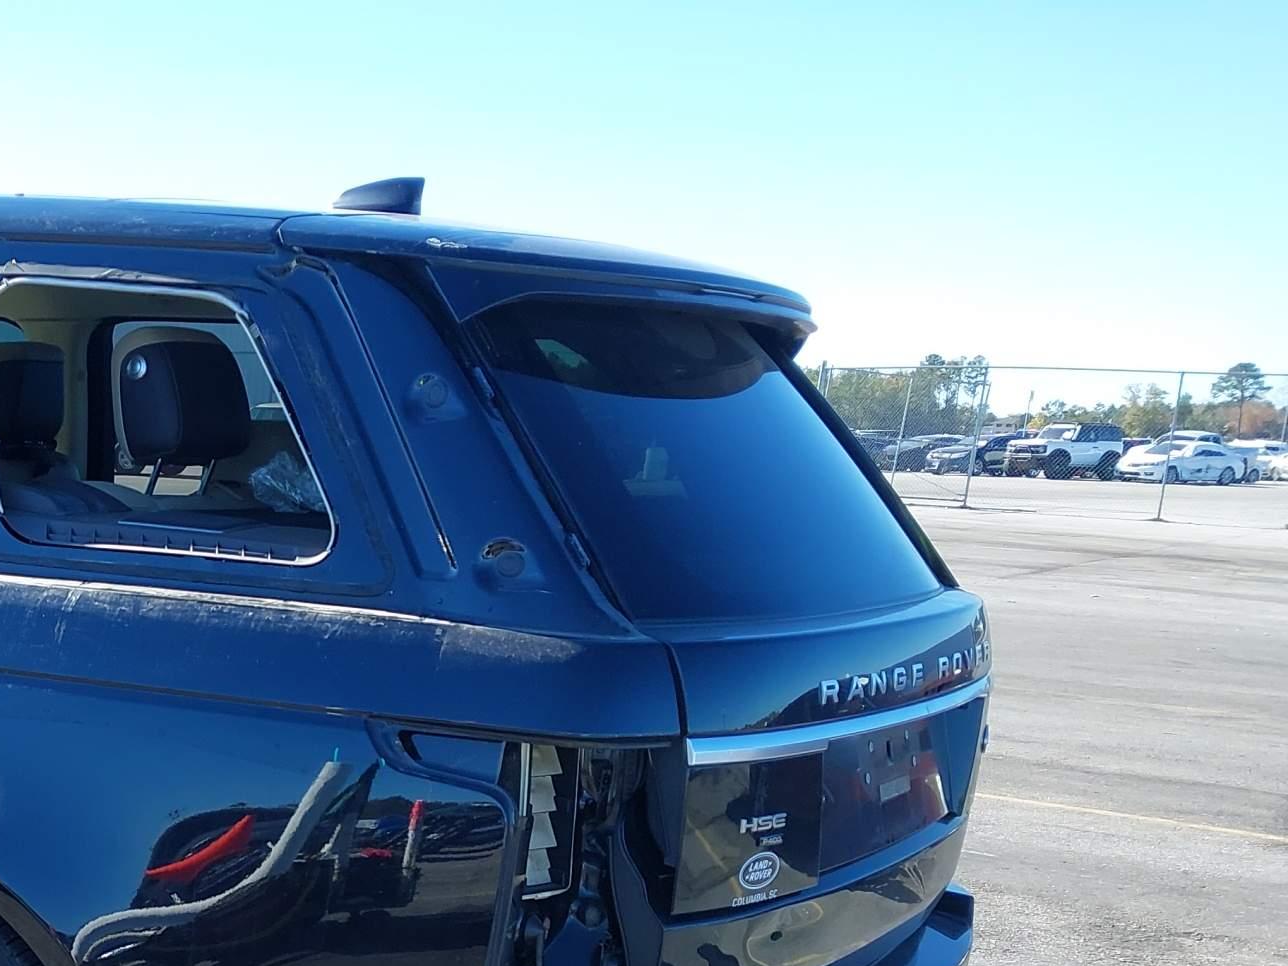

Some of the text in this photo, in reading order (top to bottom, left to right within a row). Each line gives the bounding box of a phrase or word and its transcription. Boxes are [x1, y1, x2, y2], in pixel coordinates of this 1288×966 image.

[820, 641, 990, 705] RANGE ROVER
[739, 812, 788, 834] HSE
[748, 859, 770, 872] LAND
[749, 868, 773, 881] ROVER
[768, 888, 778, 899] SC
